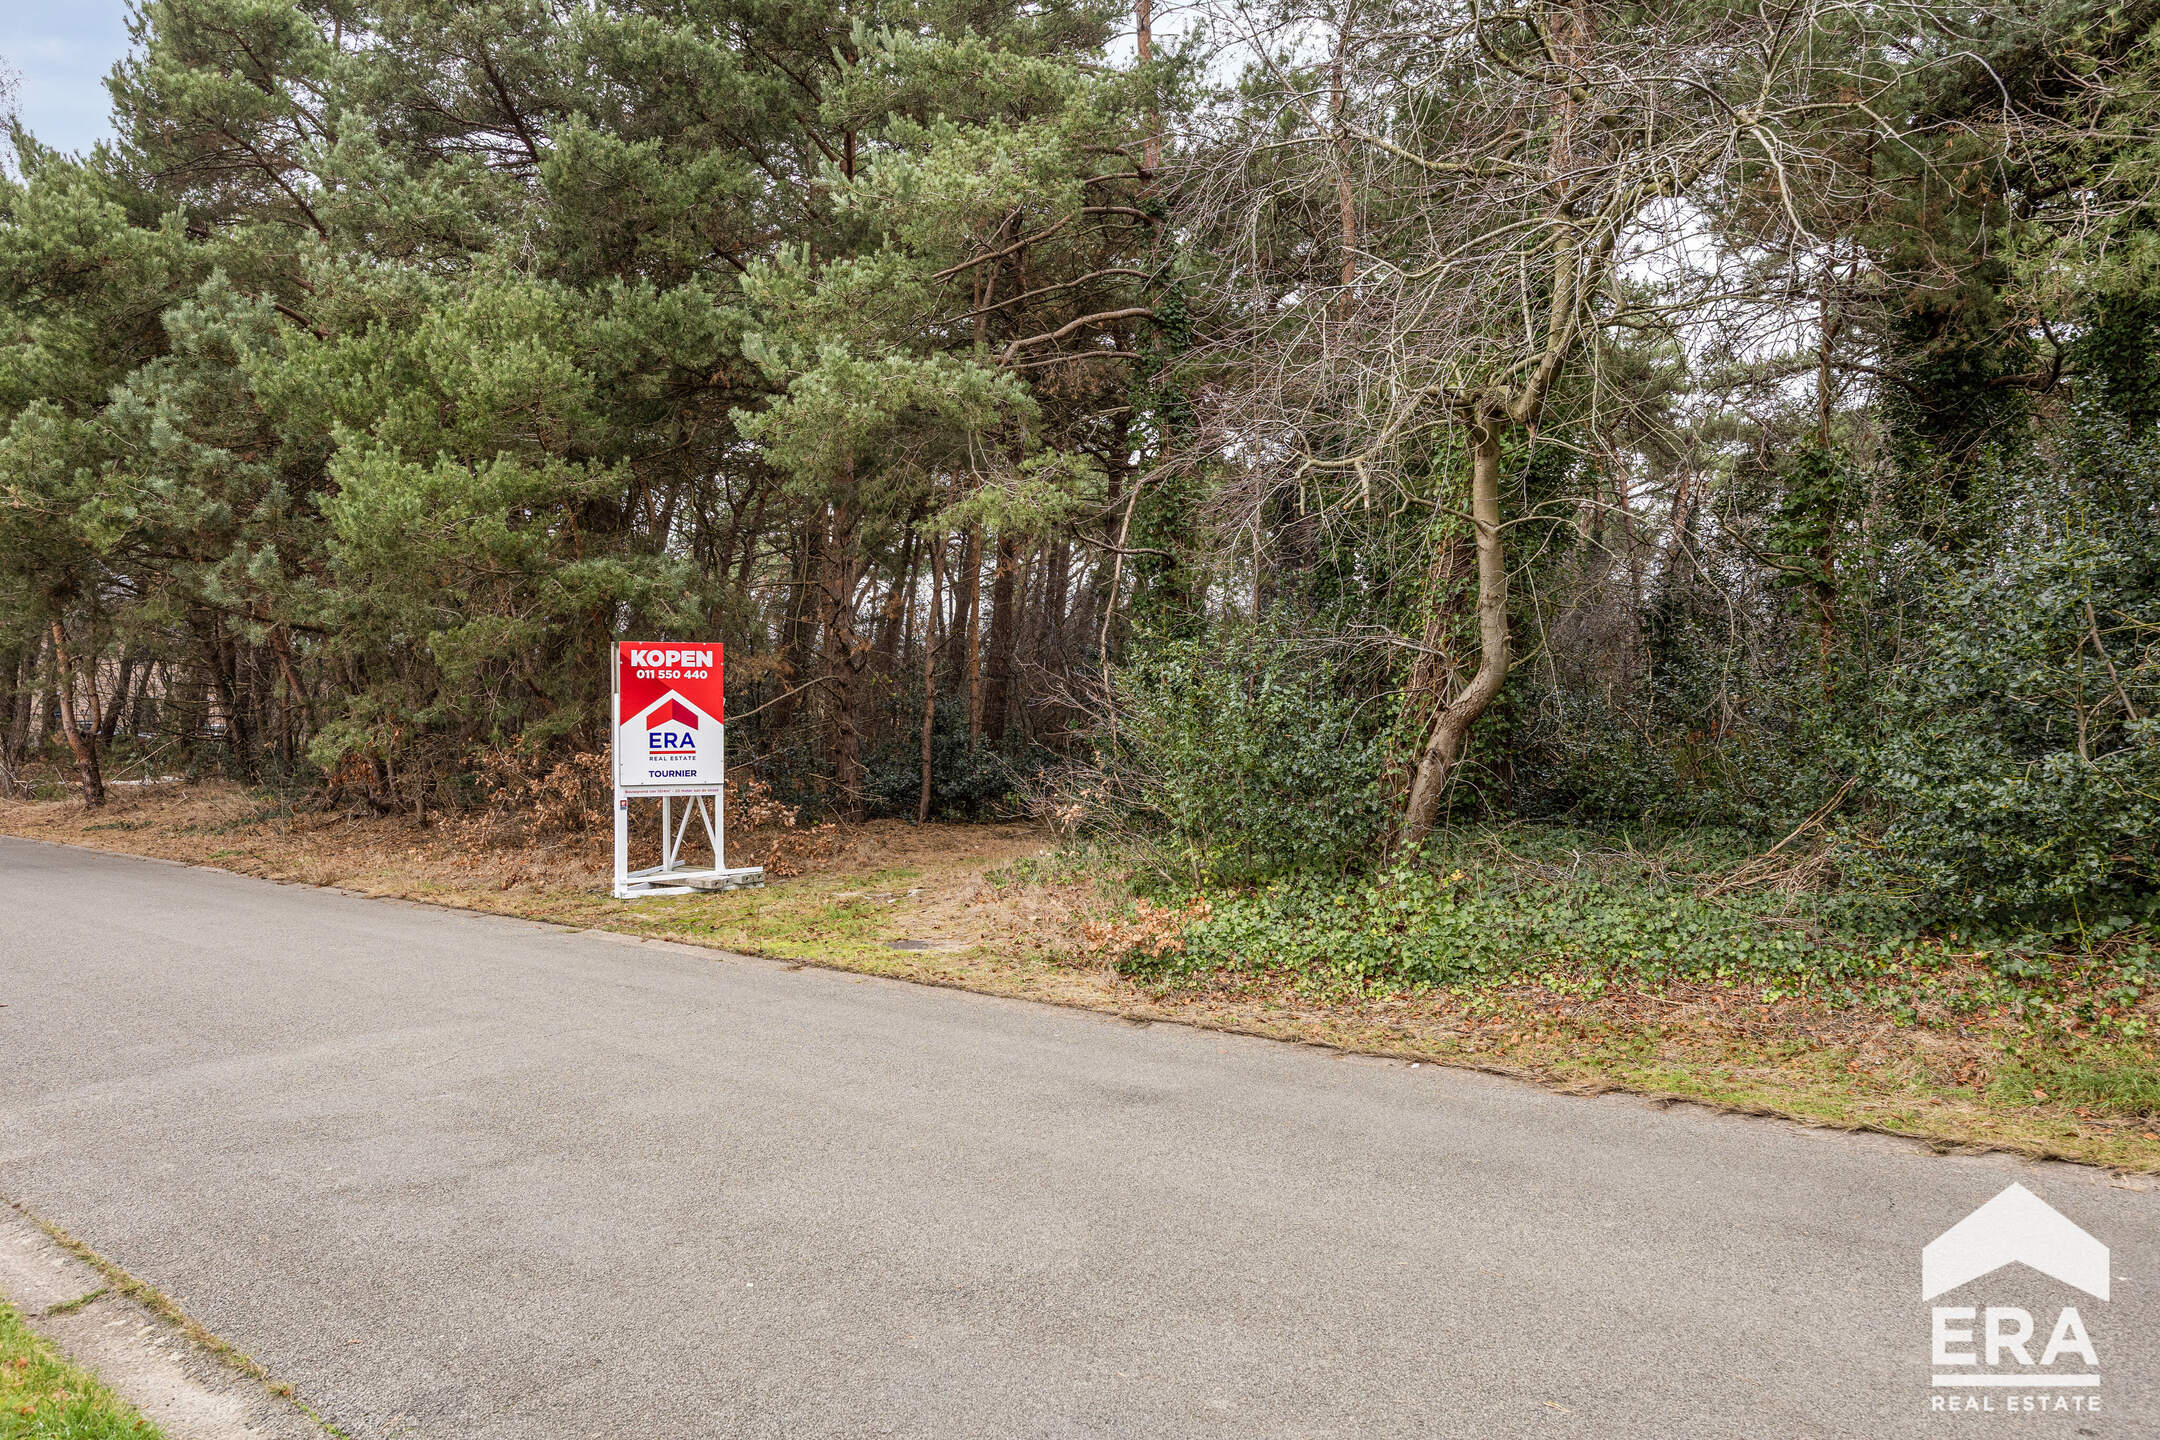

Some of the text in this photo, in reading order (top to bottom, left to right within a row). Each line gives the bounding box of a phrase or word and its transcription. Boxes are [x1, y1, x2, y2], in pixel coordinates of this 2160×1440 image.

[630, 649, 713, 668] KOPEN
[636, 670, 708, 680] 011 550 440
[649, 732, 696, 749] ERA
[649, 769, 697, 778] TOURNIER
